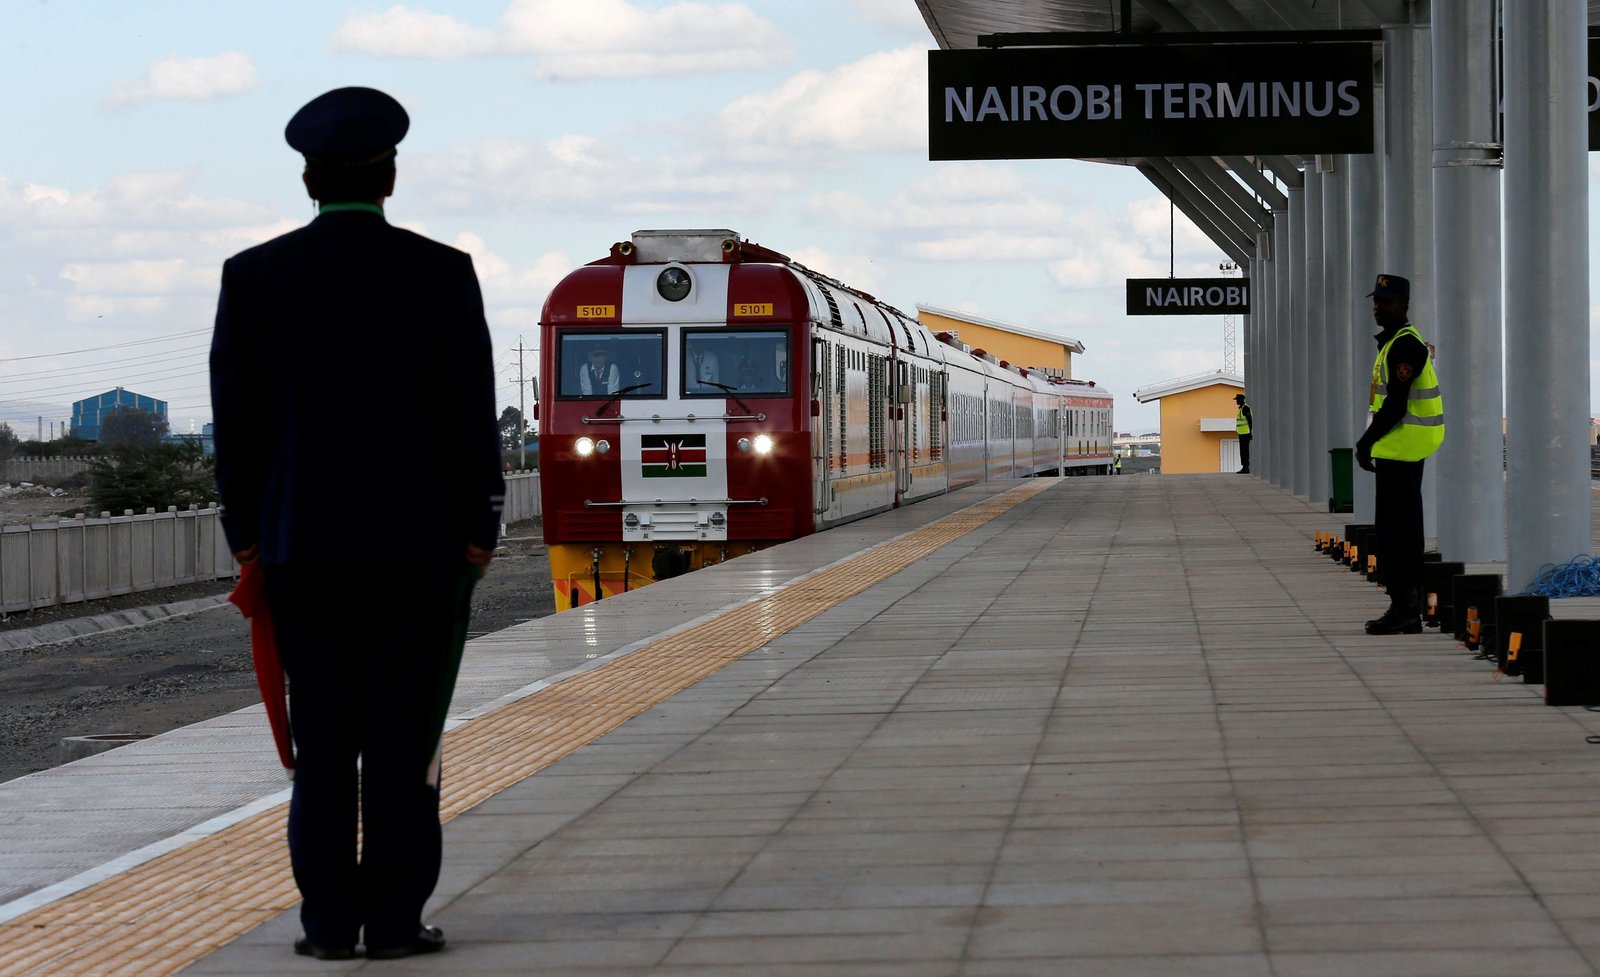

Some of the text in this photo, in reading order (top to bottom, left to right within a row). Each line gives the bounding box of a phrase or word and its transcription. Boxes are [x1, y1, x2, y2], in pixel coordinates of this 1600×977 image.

[944, 80, 1360, 123] NAIROBI TERMINUS
[1146, 286, 1247, 307] NAIROBI
[582, 306, 608, 317] 5101
[740, 304, 766, 315] 5101
